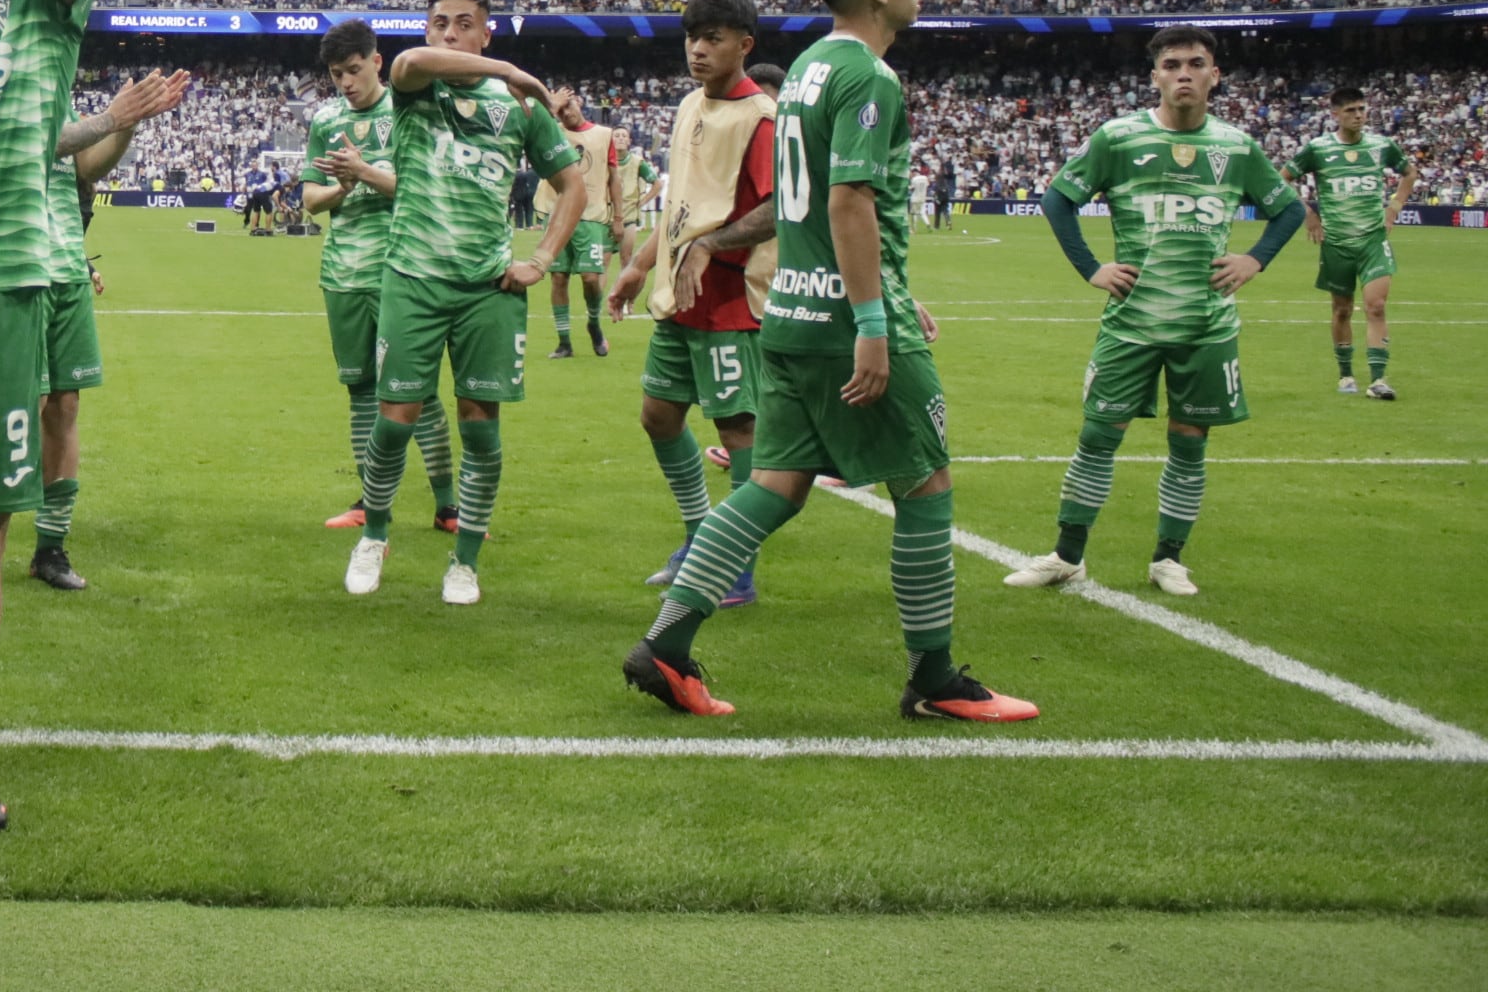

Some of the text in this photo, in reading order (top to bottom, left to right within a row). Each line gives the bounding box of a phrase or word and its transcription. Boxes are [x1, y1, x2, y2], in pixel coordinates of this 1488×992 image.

[111, 16, 139, 26] REAL
[140, 16, 185, 27] MADRID
[230, 16, 241, 30] 3
[276, 17, 318, 31] 90:00
[775, 115, 811, 222] 10
[1327, 176, 1379, 194] TPS
[146, 195, 185, 208] UEFA
[1005, 203, 1044, 216] UEFA
[1131, 194, 1226, 226] TPS
[772, 266, 847, 299] NDAÑO
[709, 345, 742, 382] 15
[6, 408, 30, 462] 9
